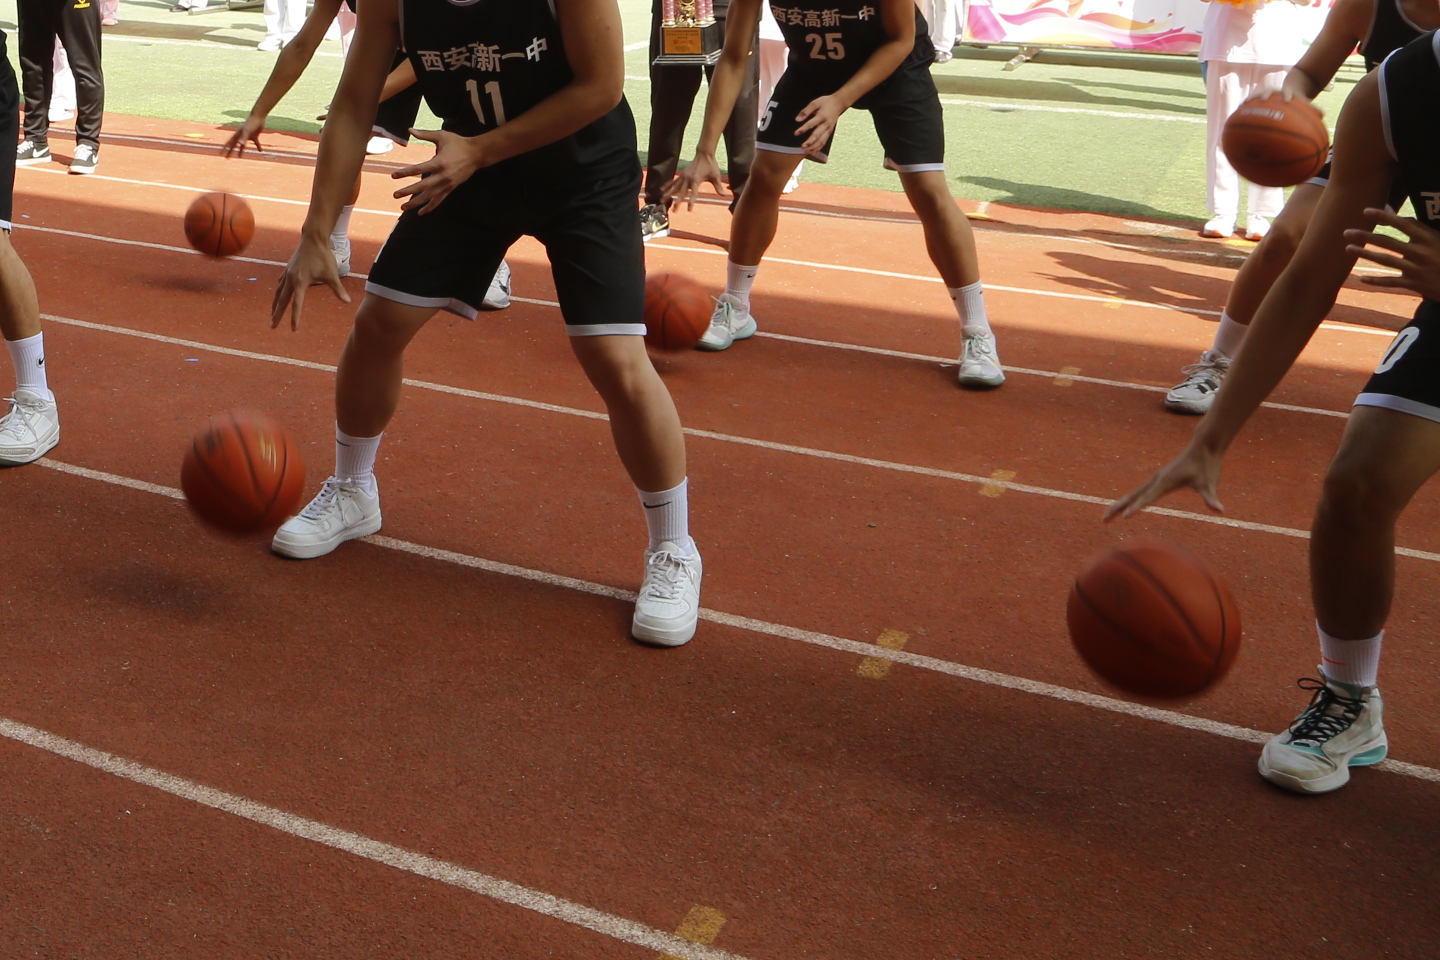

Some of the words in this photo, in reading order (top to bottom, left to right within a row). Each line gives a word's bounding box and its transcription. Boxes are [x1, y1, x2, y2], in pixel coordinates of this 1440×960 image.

[770, 5, 875, 27] 西安高新一中
[805, 32, 845, 60] 25
[465, 79, 506, 127] 11
